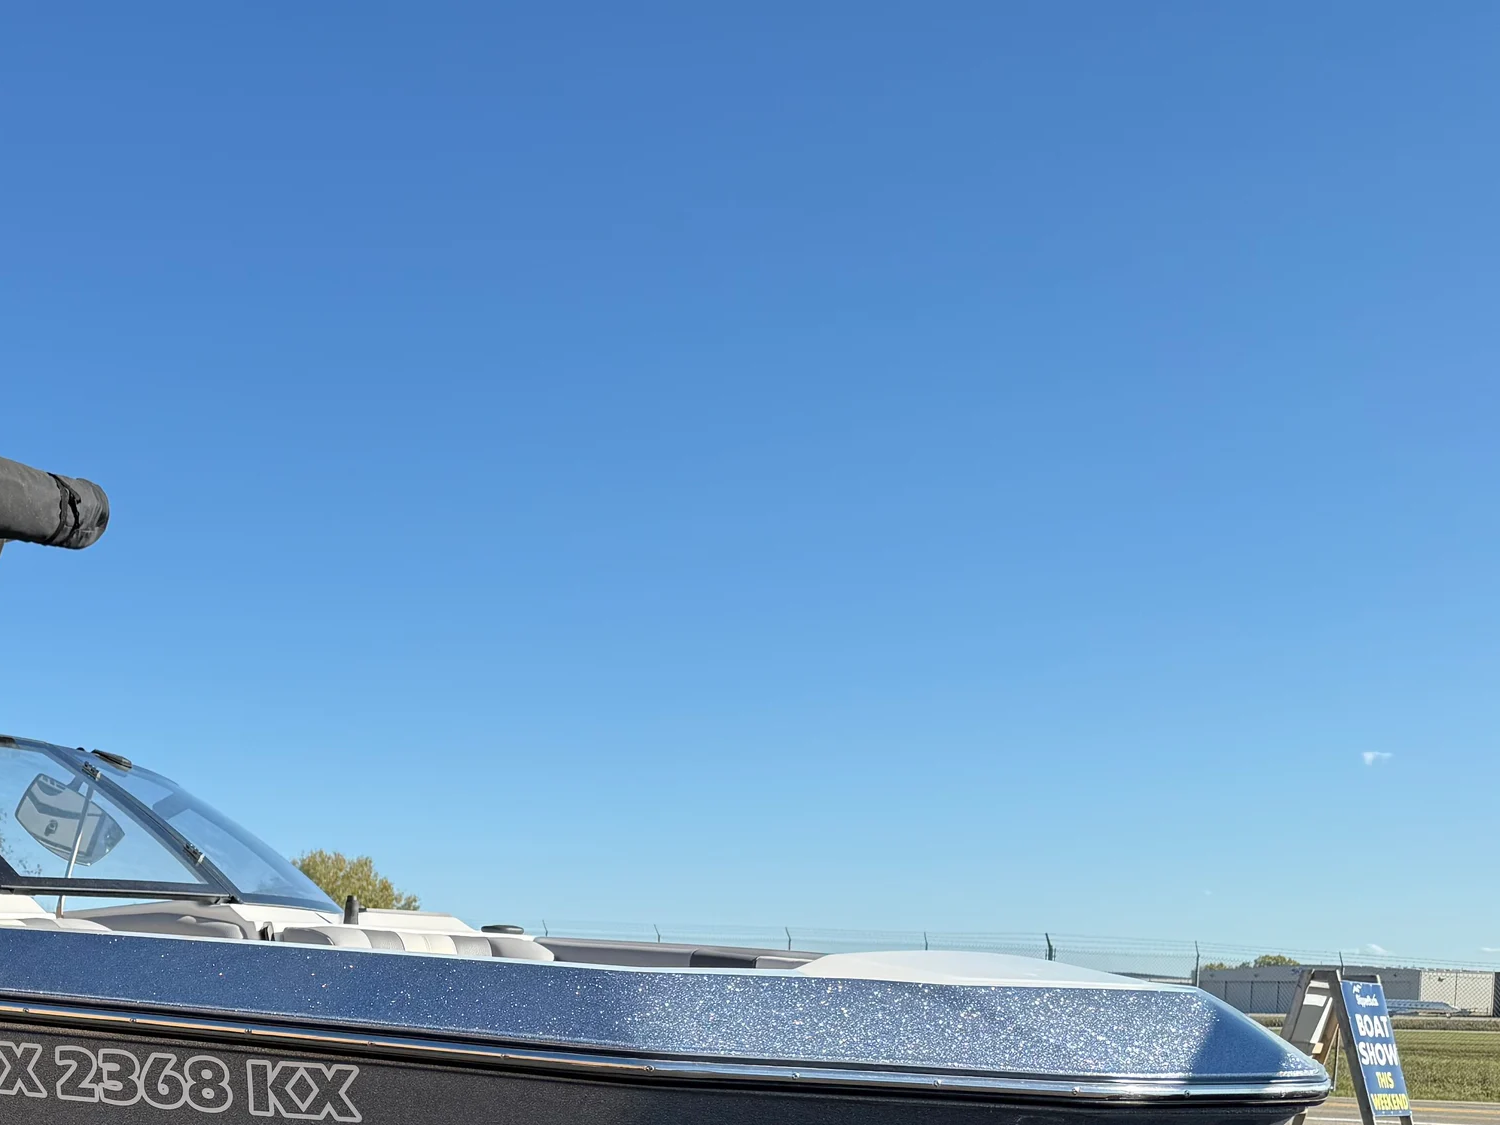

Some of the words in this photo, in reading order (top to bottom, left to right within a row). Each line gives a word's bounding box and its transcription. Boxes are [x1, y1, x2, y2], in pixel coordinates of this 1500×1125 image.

[1355, 1013, 1390, 1038] BOAT
[1358, 1042, 1399, 1066] SHOW
[55, 1045, 233, 1113] 2368
[245, 1059, 362, 1123] KX
[1375, 1071, 1395, 1089] THIS
[1372, 1093, 1409, 1111] WEEKEND
